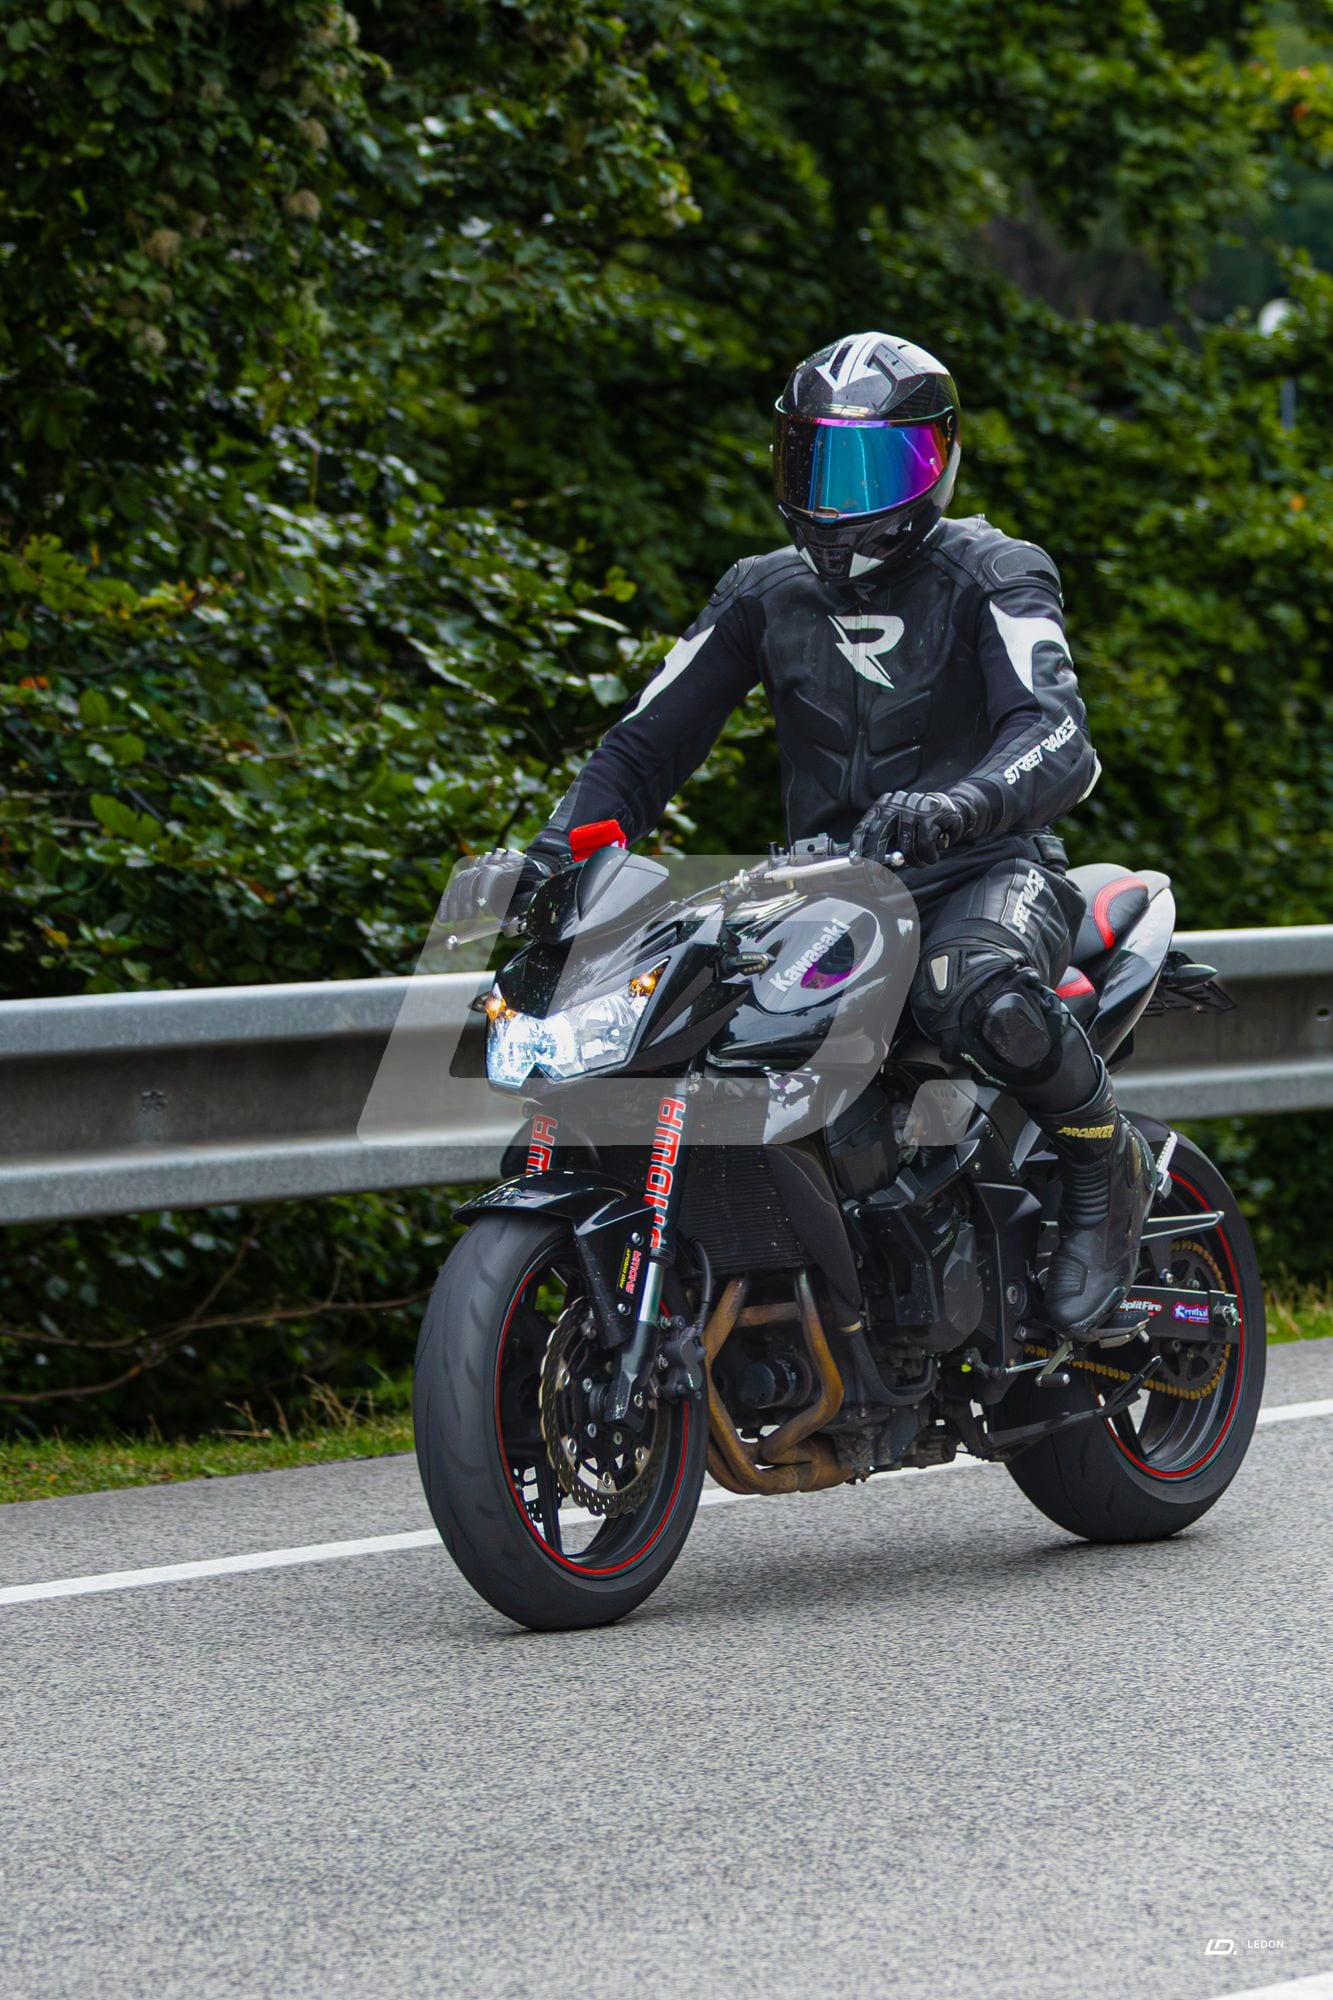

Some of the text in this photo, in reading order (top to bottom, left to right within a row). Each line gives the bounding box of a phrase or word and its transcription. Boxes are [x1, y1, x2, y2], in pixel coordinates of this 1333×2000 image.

[1003, 715, 1078, 785] STREET RACER
[768, 918, 851, 992] Kawasaki
